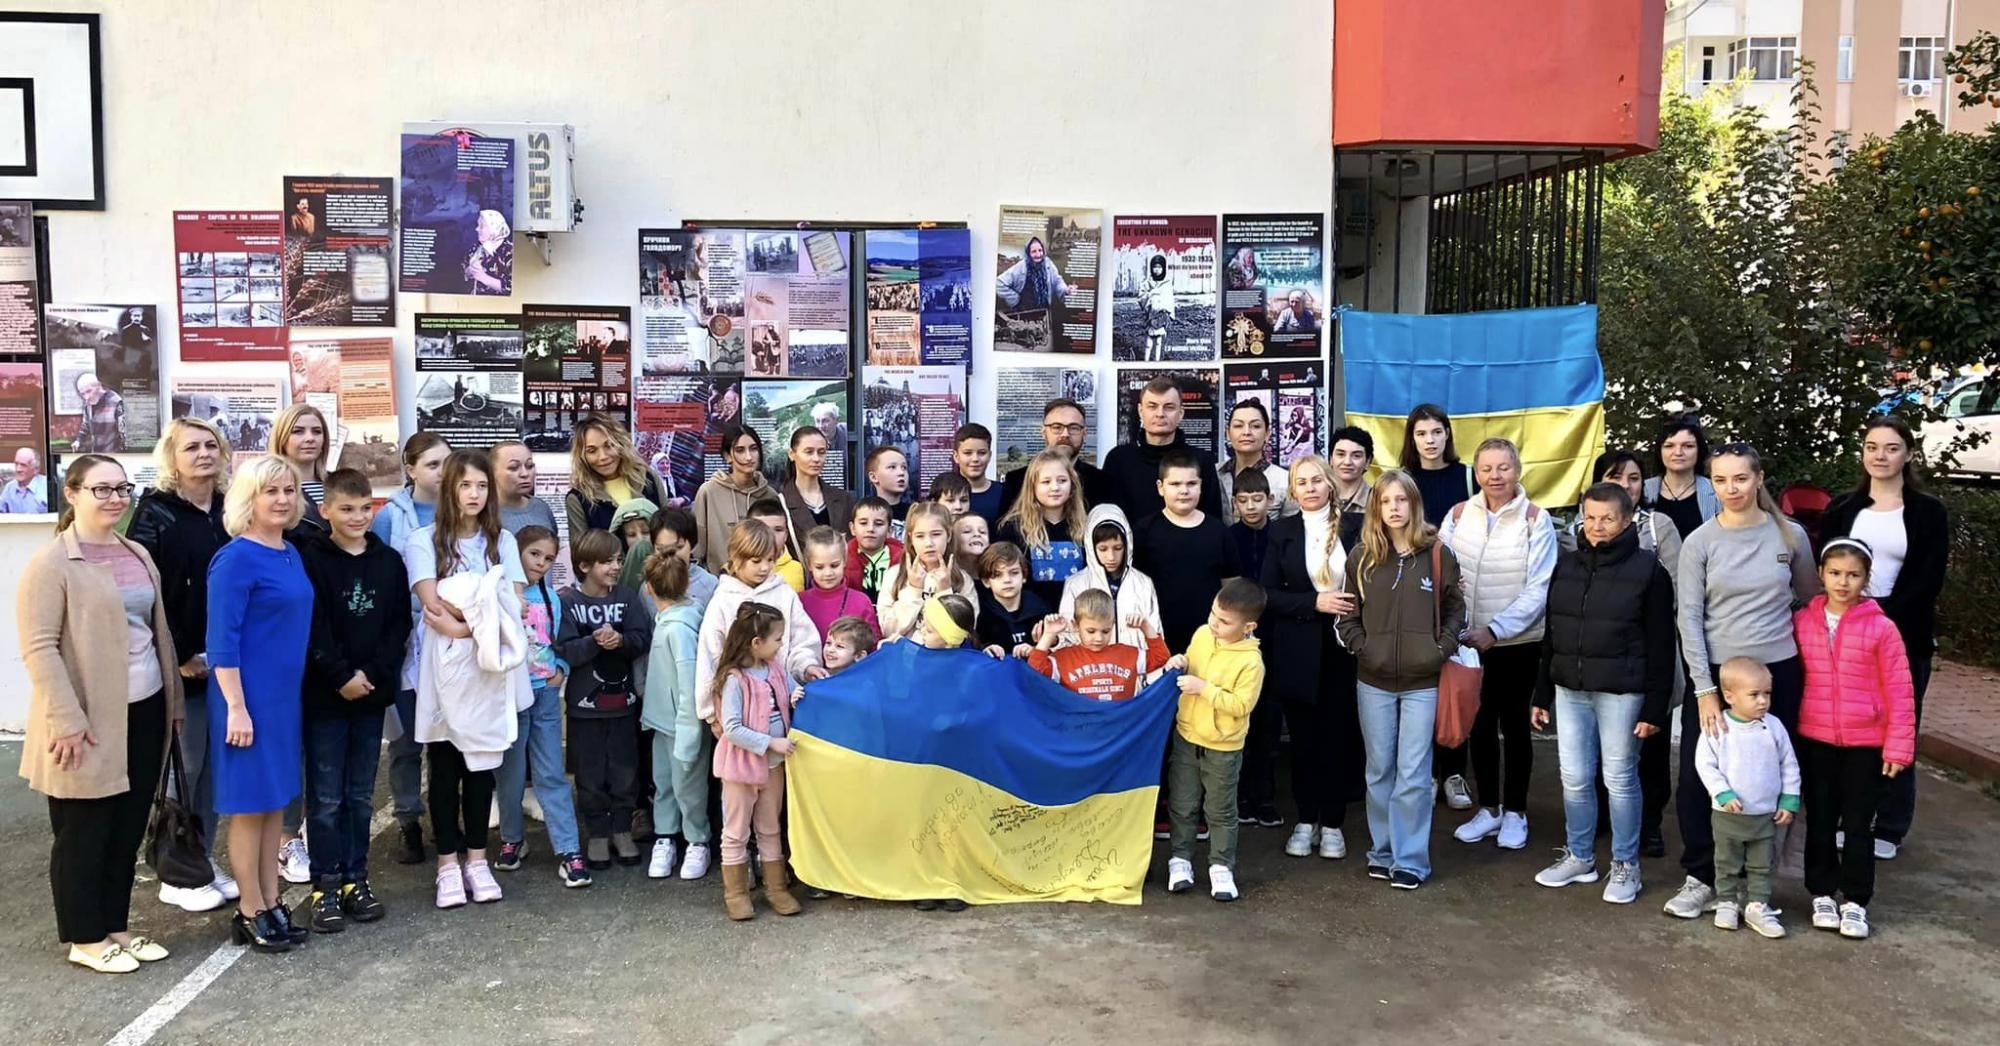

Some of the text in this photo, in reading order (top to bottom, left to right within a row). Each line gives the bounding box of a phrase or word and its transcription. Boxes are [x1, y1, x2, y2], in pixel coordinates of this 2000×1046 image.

[1117, 227, 1213, 236] THE UNKNOWN GENOCIDE
[1068, 663, 1131, 683] ATHLETICS
